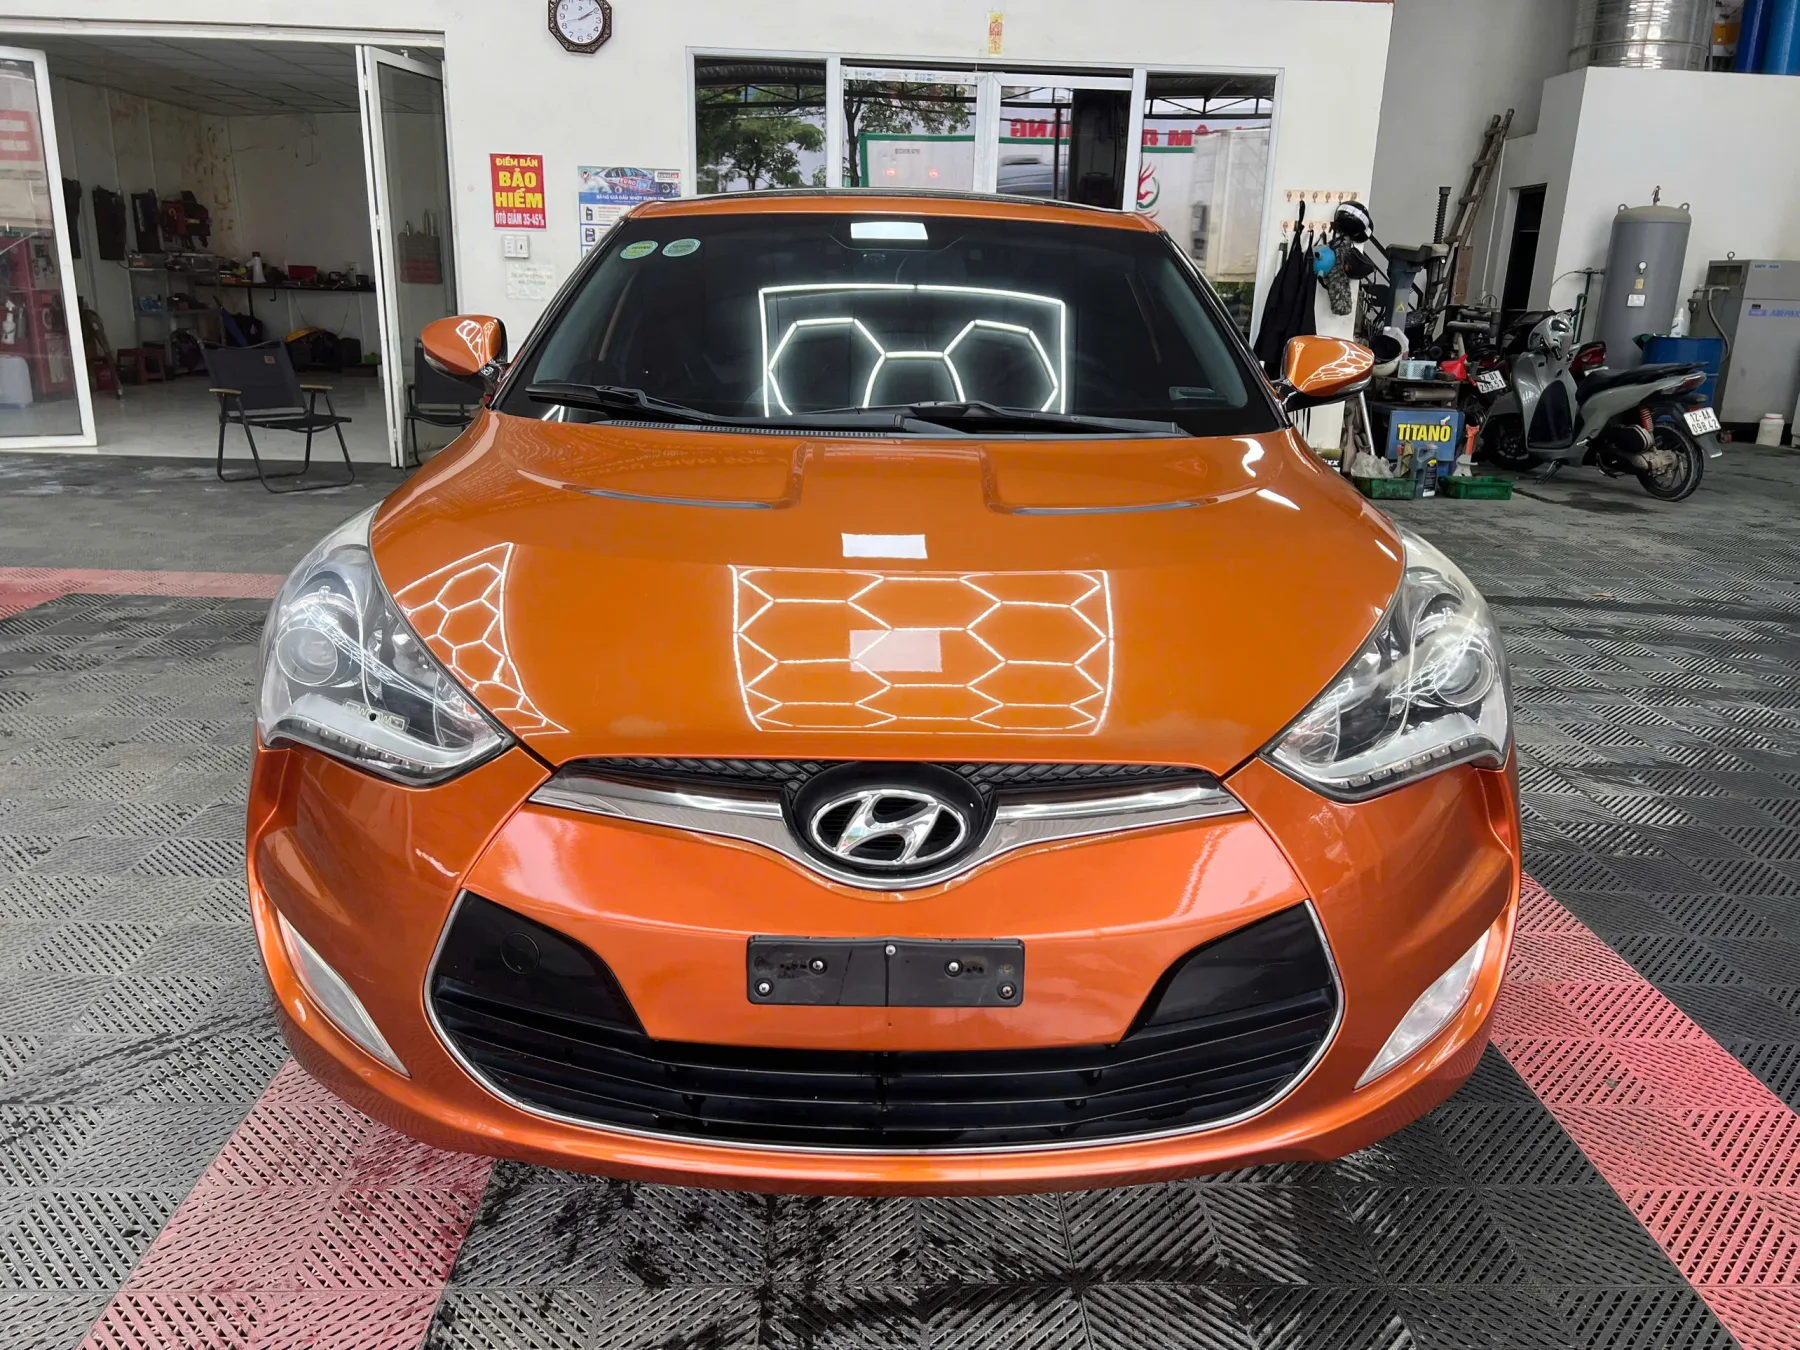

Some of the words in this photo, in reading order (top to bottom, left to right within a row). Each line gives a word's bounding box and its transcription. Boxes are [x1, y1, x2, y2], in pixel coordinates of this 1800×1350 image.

[495, 156, 518, 166] ĐIỂM
[519, 157, 538, 167] BÁN
[498, 168, 537, 188] BẢO
[495, 188, 543, 208] HIỂM
